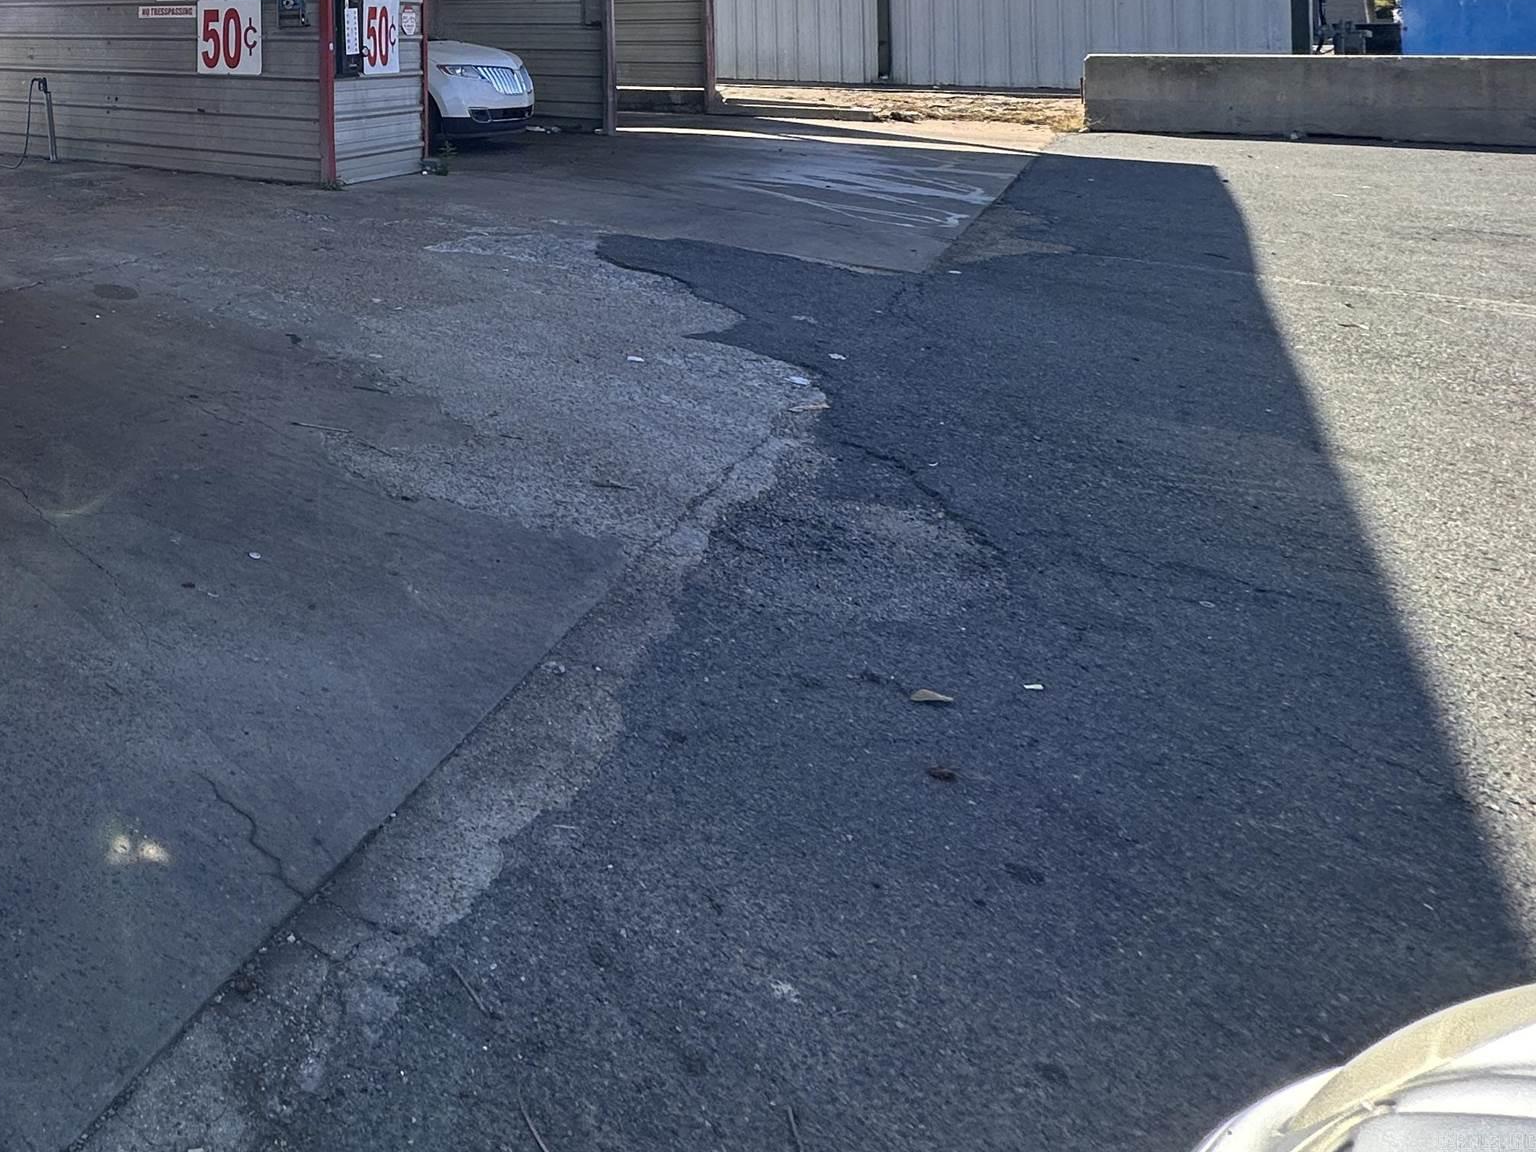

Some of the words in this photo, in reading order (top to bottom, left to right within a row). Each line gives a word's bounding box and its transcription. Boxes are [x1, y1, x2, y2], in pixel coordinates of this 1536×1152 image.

[141, 8, 151, 17] NO
[201, 7, 257, 69] 50¢
[366, 5, 397, 67] 50¢
